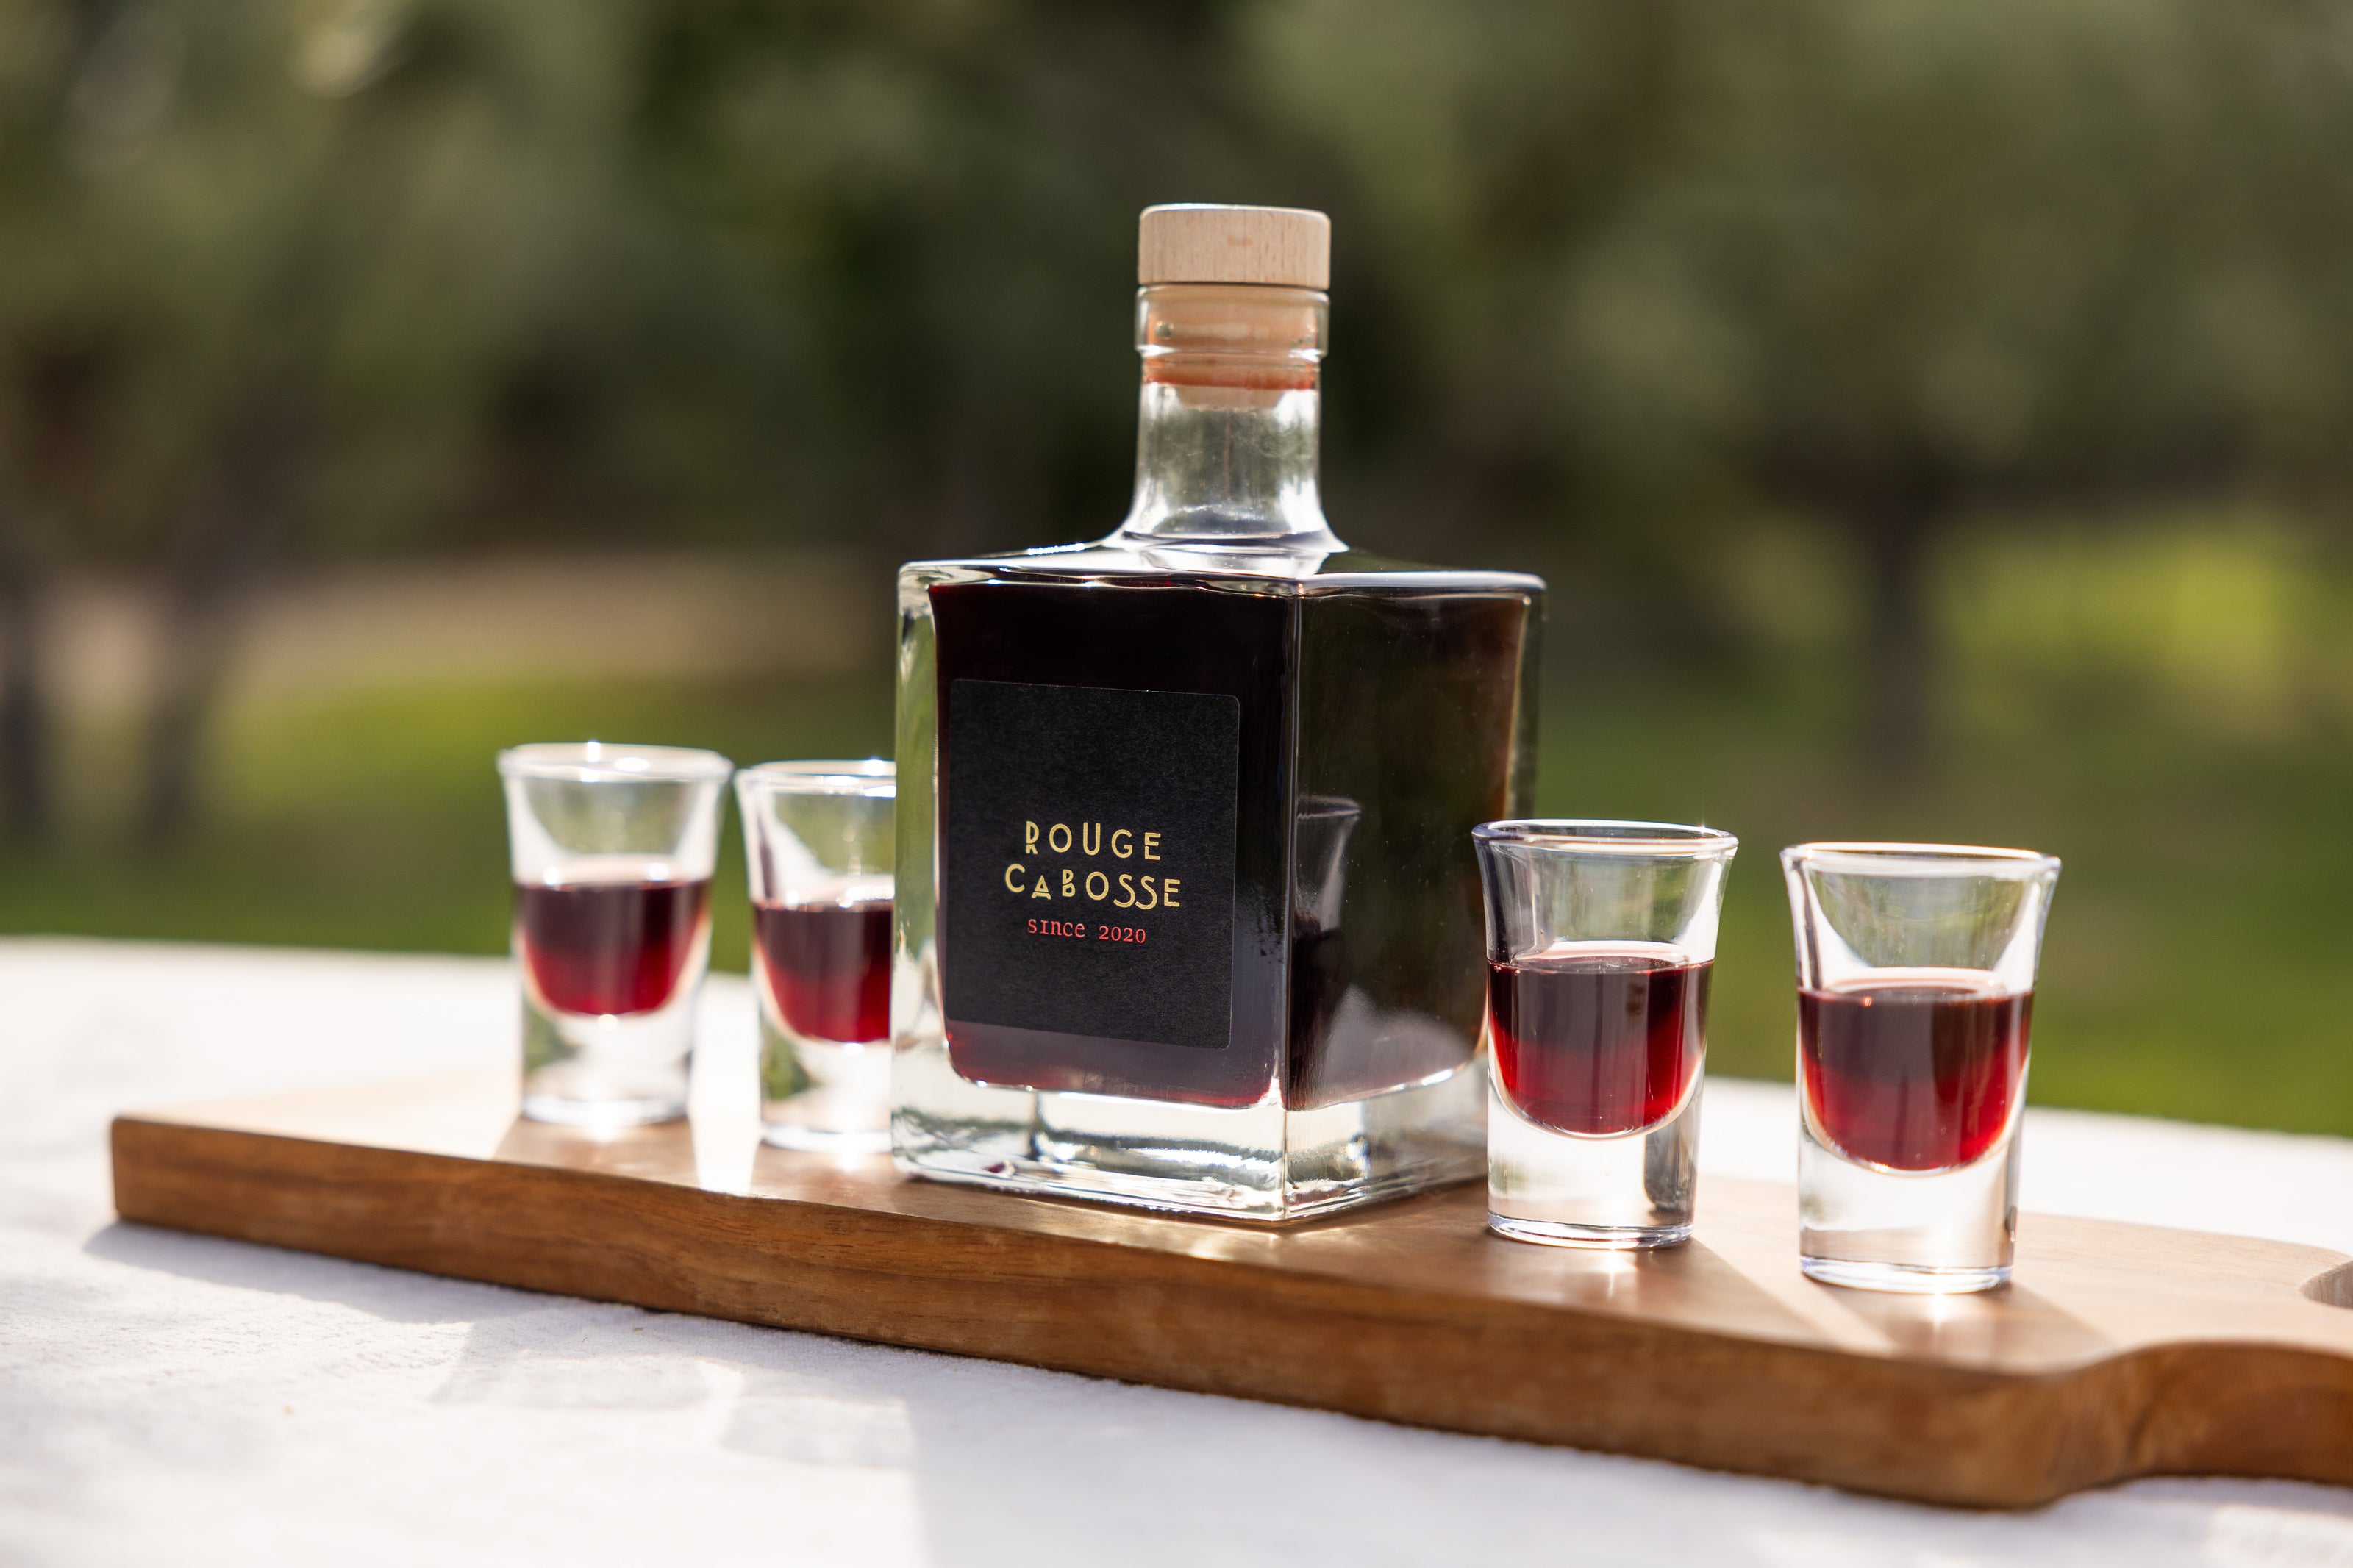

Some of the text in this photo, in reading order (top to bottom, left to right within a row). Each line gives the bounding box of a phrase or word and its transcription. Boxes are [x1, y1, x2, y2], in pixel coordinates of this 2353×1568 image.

[1025, 820, 1162, 862] ROUGE
[1004, 863, 1182, 911] CABOSSE
[1098, 925, 1148, 945] 2020
